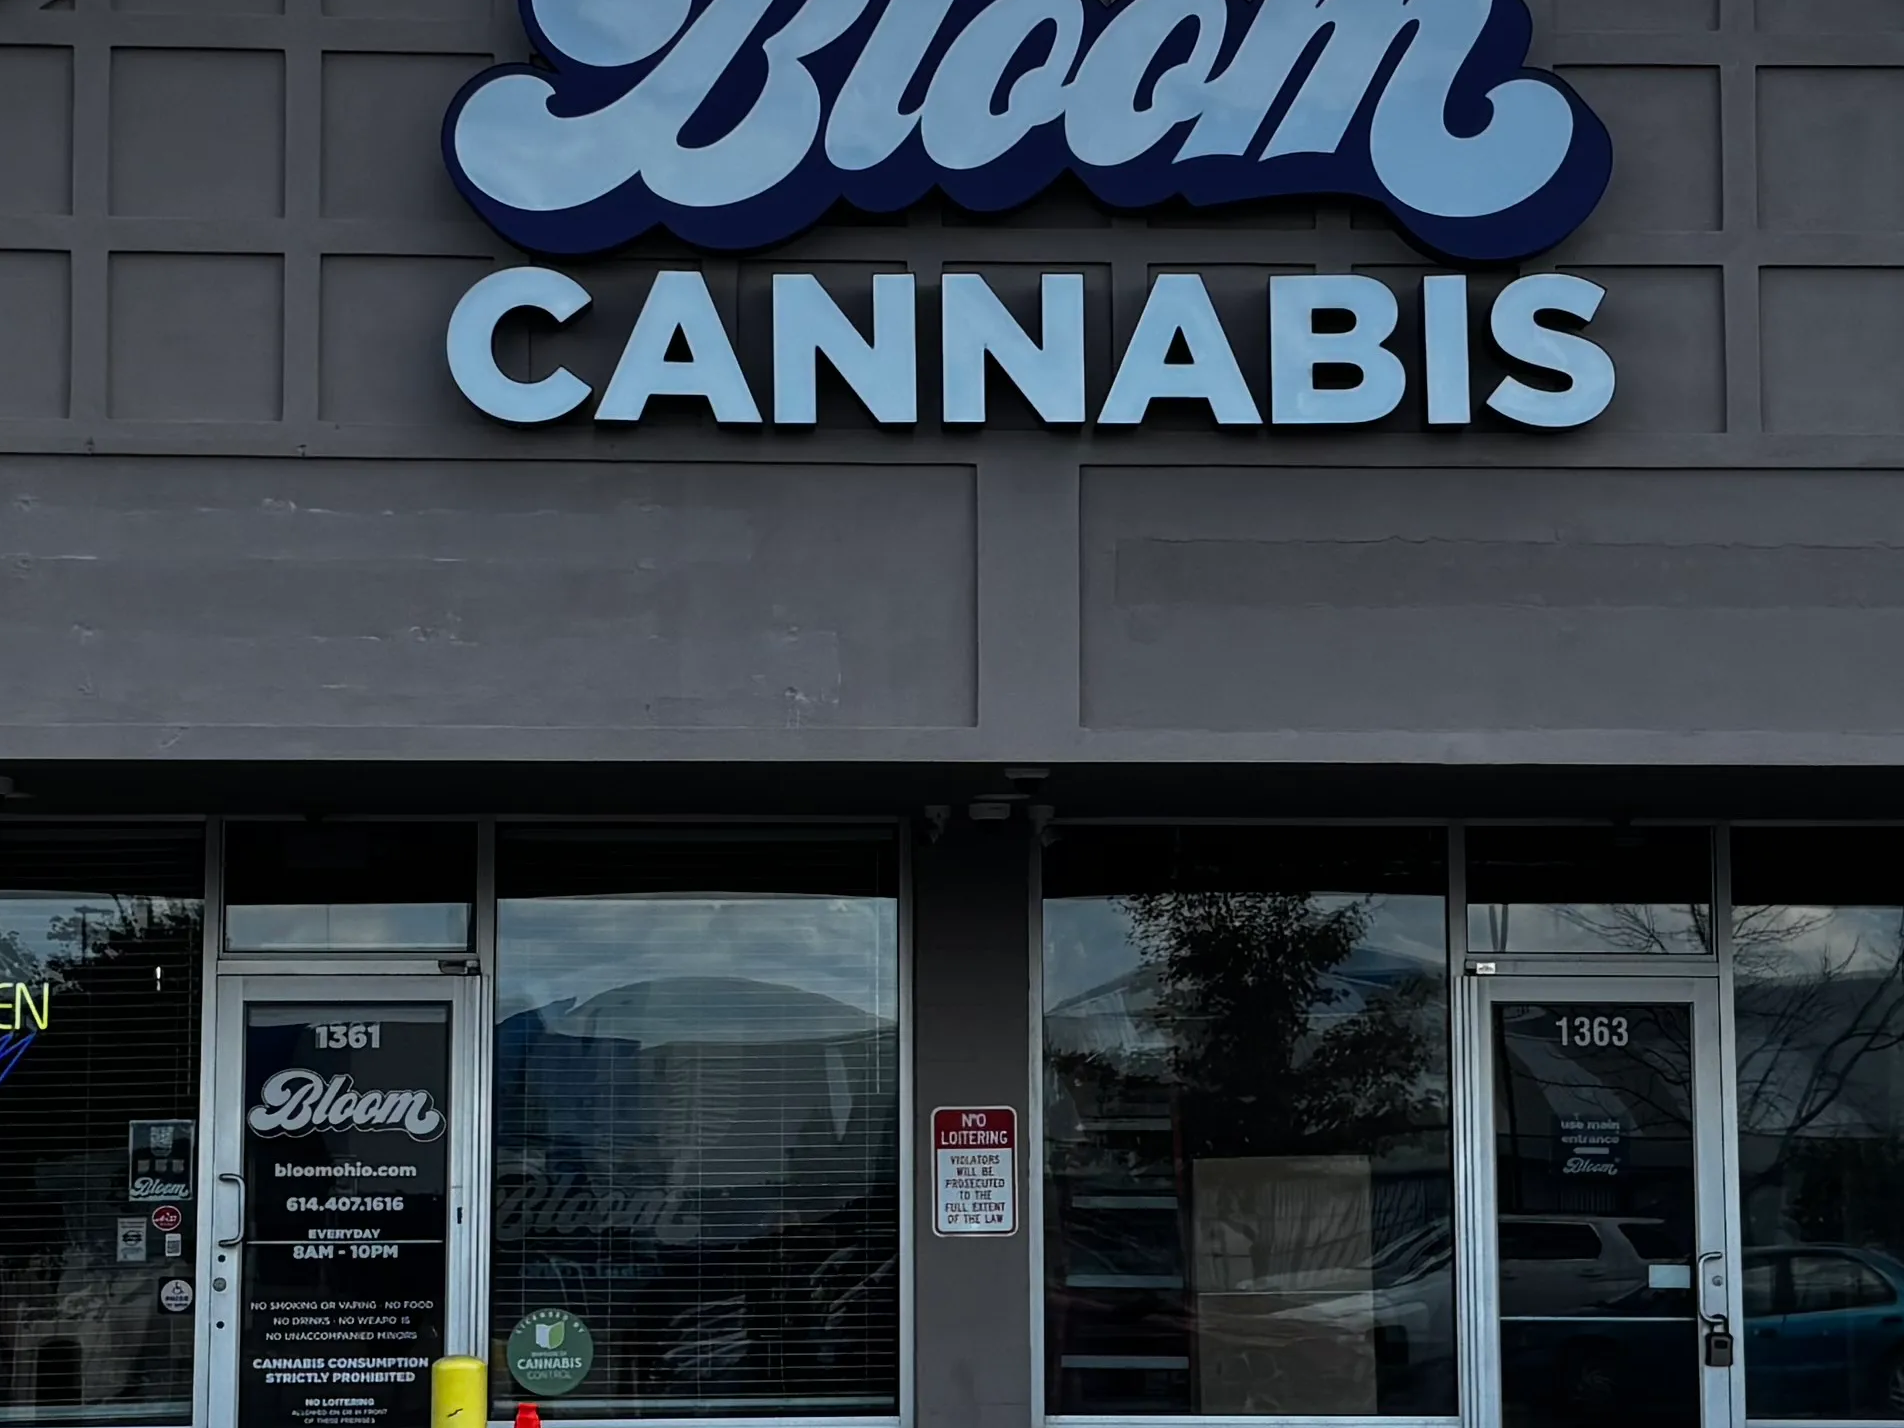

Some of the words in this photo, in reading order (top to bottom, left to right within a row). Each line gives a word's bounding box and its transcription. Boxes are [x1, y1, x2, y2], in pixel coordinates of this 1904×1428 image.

[447, 266, 1616, 428] CANNABIS
[315, 1025, 380, 1049] 1361
[1556, 1016, 1629, 1047] 1363
[248, 1068, 445, 1141] Bloom
[962, 1113, 987, 1127] NO
[1561, 1120, 1584, 1129] use
[1587, 1119, 1619, 1129] main
[941, 1131, 1008, 1145] LOITERING
[1561, 1135, 1619, 1143] entrance
[950, 1155, 1000, 1165] VIOLATORS
[275, 1161, 417, 1177] bloomohio.com
[957, 1167, 976, 1176] WILL
[982, 1166, 994, 1176] BE
[130, 1177, 189, 1197] Bloom
[945, 1178, 1005, 1189] PROSECUTED
[959, 1191, 970, 1200] TO
[975, 1190, 992, 1200] THE
[286, 1196, 404, 1212] 614.407.1616
[945, 1202, 968, 1212] FULL
[972, 1202, 1005, 1212] EXTENT
[948, 1215, 959, 1224] OF
[964, 1214, 980, 1224] THE
[985, 1214, 1003, 1223] LAW
[308, 1228, 381, 1239] EVERYDAY
[293, 1245, 334, 1259] 8AM
[350, 1244, 399, 1259] 10PM
[250, 1302, 267, 1310] NO
[270, 1301, 318, 1310] SMOKING
[320, 1301, 336, 1310] OR
[338, 1301, 377, 1310] VAPING
[385, 1301, 401, 1309] NO
[403, 1301, 434, 1309] FOOD
[273, 1317, 289, 1326] NO
[292, 1317, 330, 1325] DRINKS
[339, 1316, 355, 1325] NO
[266, 1332, 282, 1341] NO
[284, 1332, 374, 1341] UNACCOMPANIED
[377, 1331, 418, 1340] MINORS
[252, 1358, 325, 1369] CANNABIS
[327, 1357, 429, 1369] CONSUMPTION
[517, 1357, 583, 1370] CANNABIS
[265, 1372, 329, 1383] STRICTLY
[332, 1372, 416, 1383] PROHIBITED
[526, 1370, 572, 1381] CONTROL
[305, 1398, 320, 1407] NO
[322, 1398, 375, 1407] LOITERING
